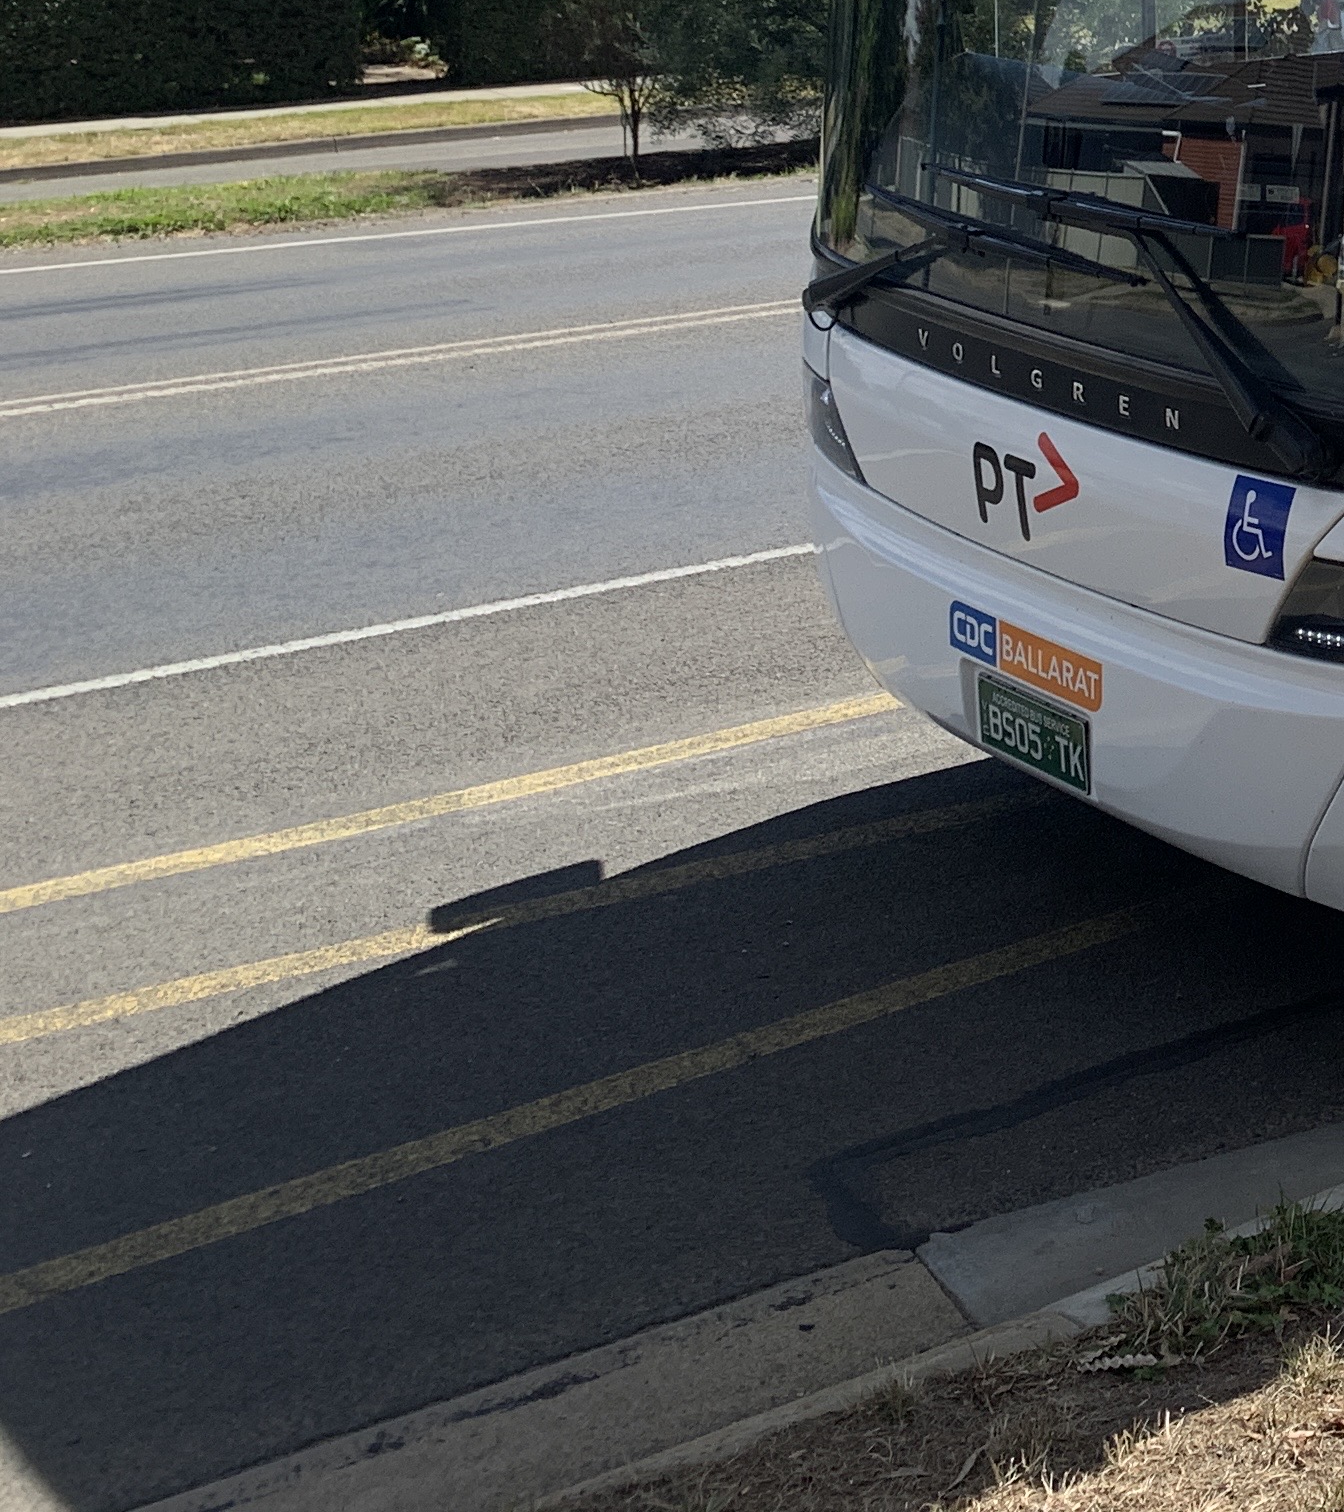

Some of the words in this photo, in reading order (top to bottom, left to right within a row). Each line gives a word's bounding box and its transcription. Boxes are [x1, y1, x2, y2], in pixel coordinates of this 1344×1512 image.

[916, 328, 1182, 431] VOLGREN
[973, 440, 1036, 541] PT
[953, 610, 993, 656] CDC
[1001, 633, 1099, 700] BALLARAT
[988, 704, 1043, 761] BS05
[1054, 734, 1085, 782] TK
